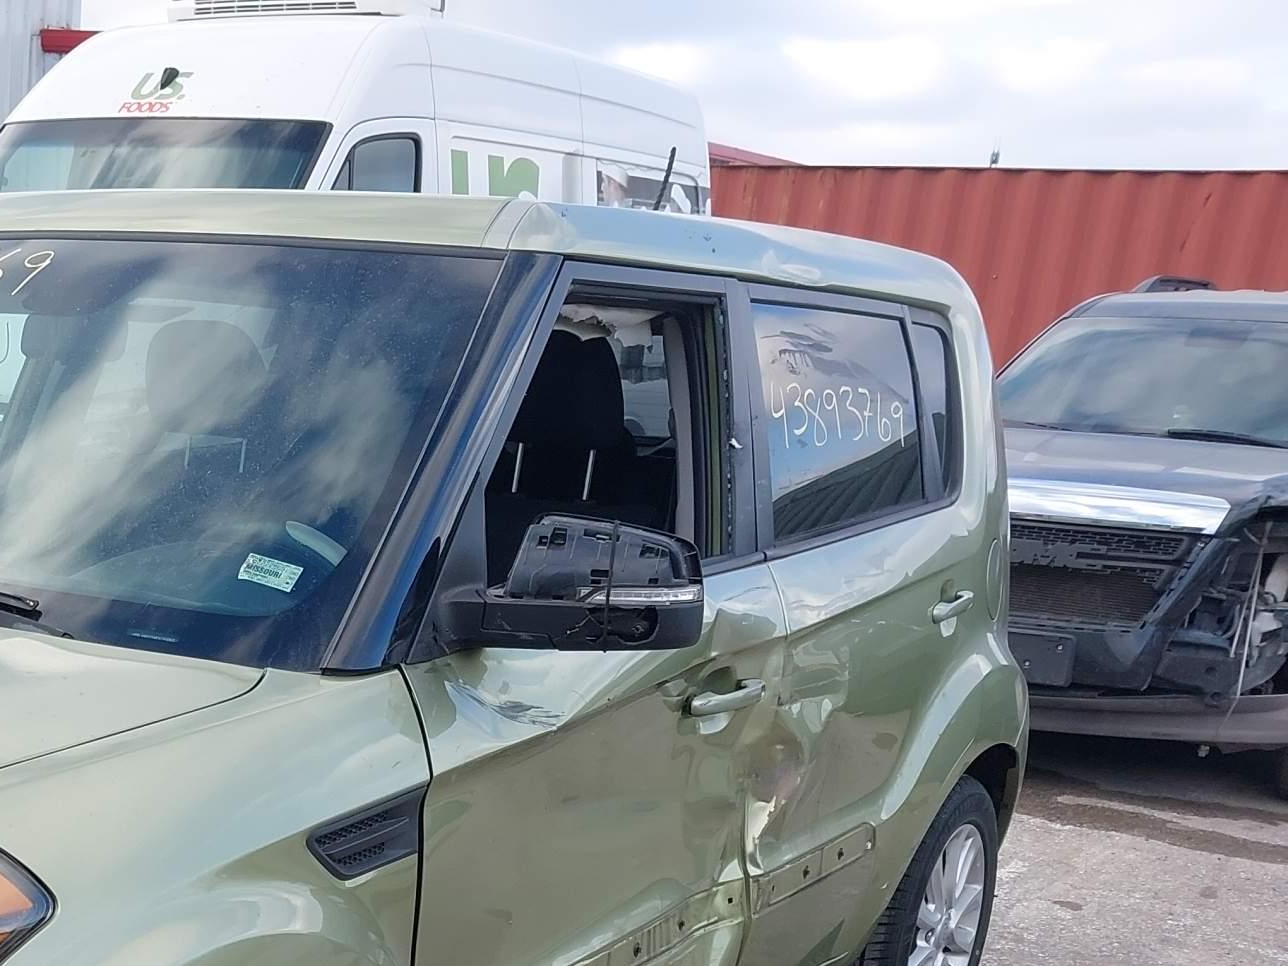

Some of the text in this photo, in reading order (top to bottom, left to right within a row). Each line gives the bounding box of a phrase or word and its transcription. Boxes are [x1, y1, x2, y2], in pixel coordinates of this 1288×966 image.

[117, 101, 173, 113] FOODS
[770, 381, 906, 448] 43893769
[245, 563, 283, 579] MISSOURI
